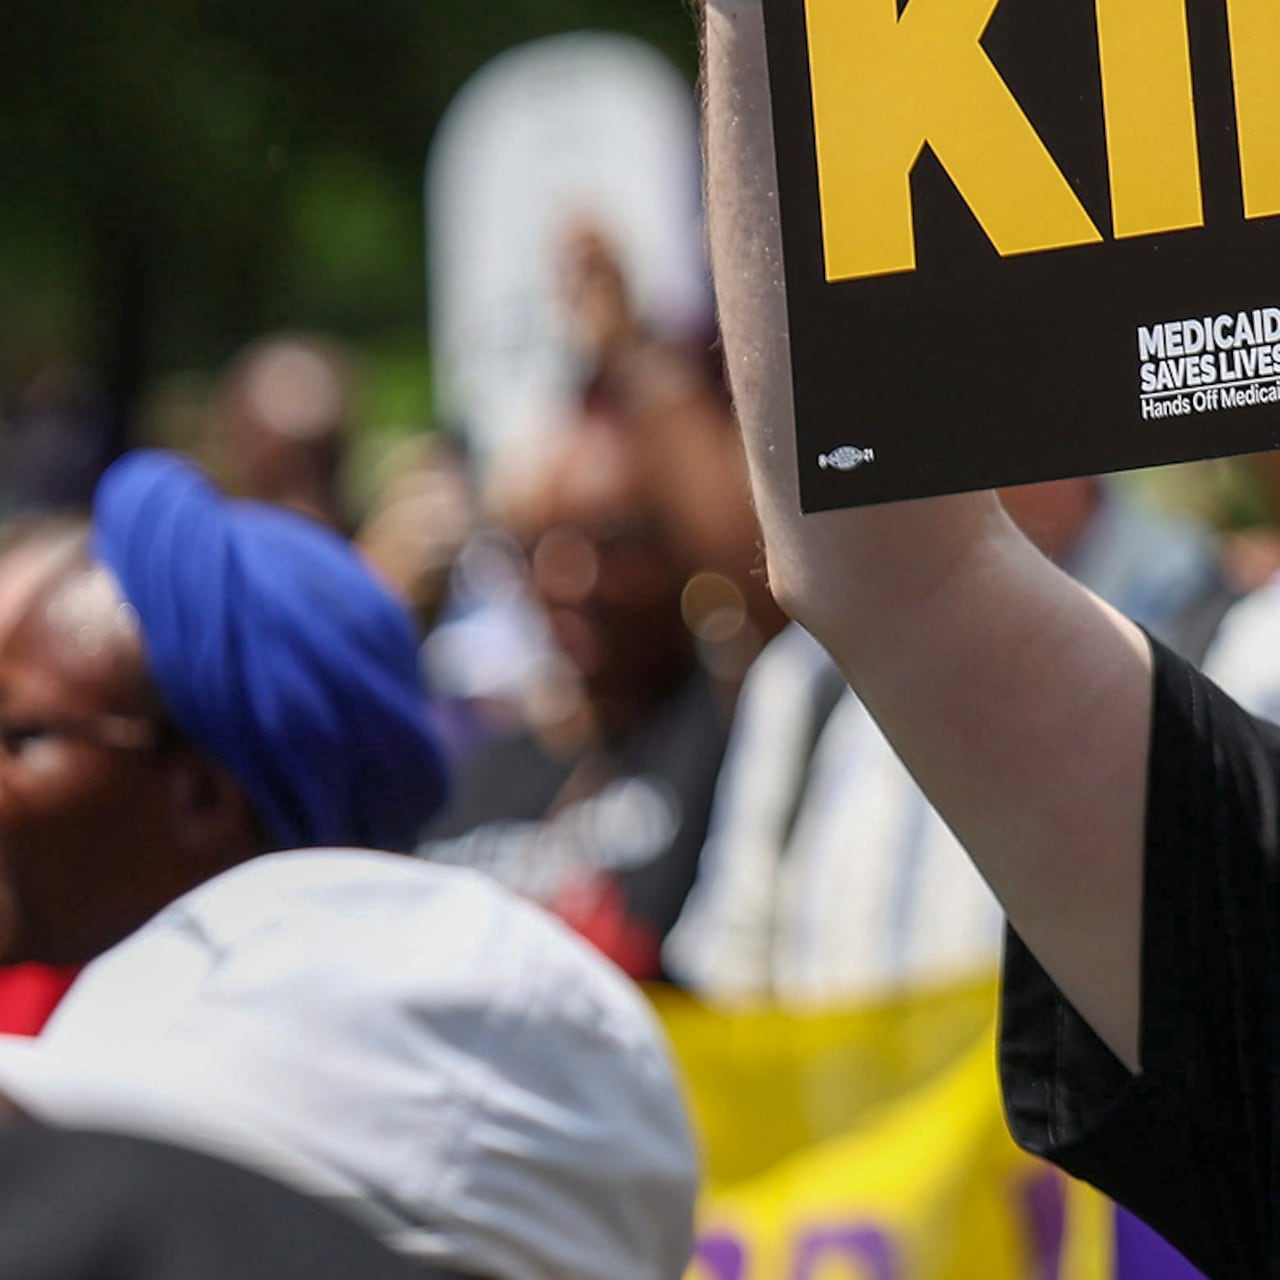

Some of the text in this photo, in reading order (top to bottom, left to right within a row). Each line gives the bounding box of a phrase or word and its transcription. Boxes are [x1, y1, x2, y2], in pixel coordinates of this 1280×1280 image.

[1140, 353, 1216, 392] SAVES
[1141, 395, 1191, 420] Hands
[1192, 388, 1219, 412] Off
